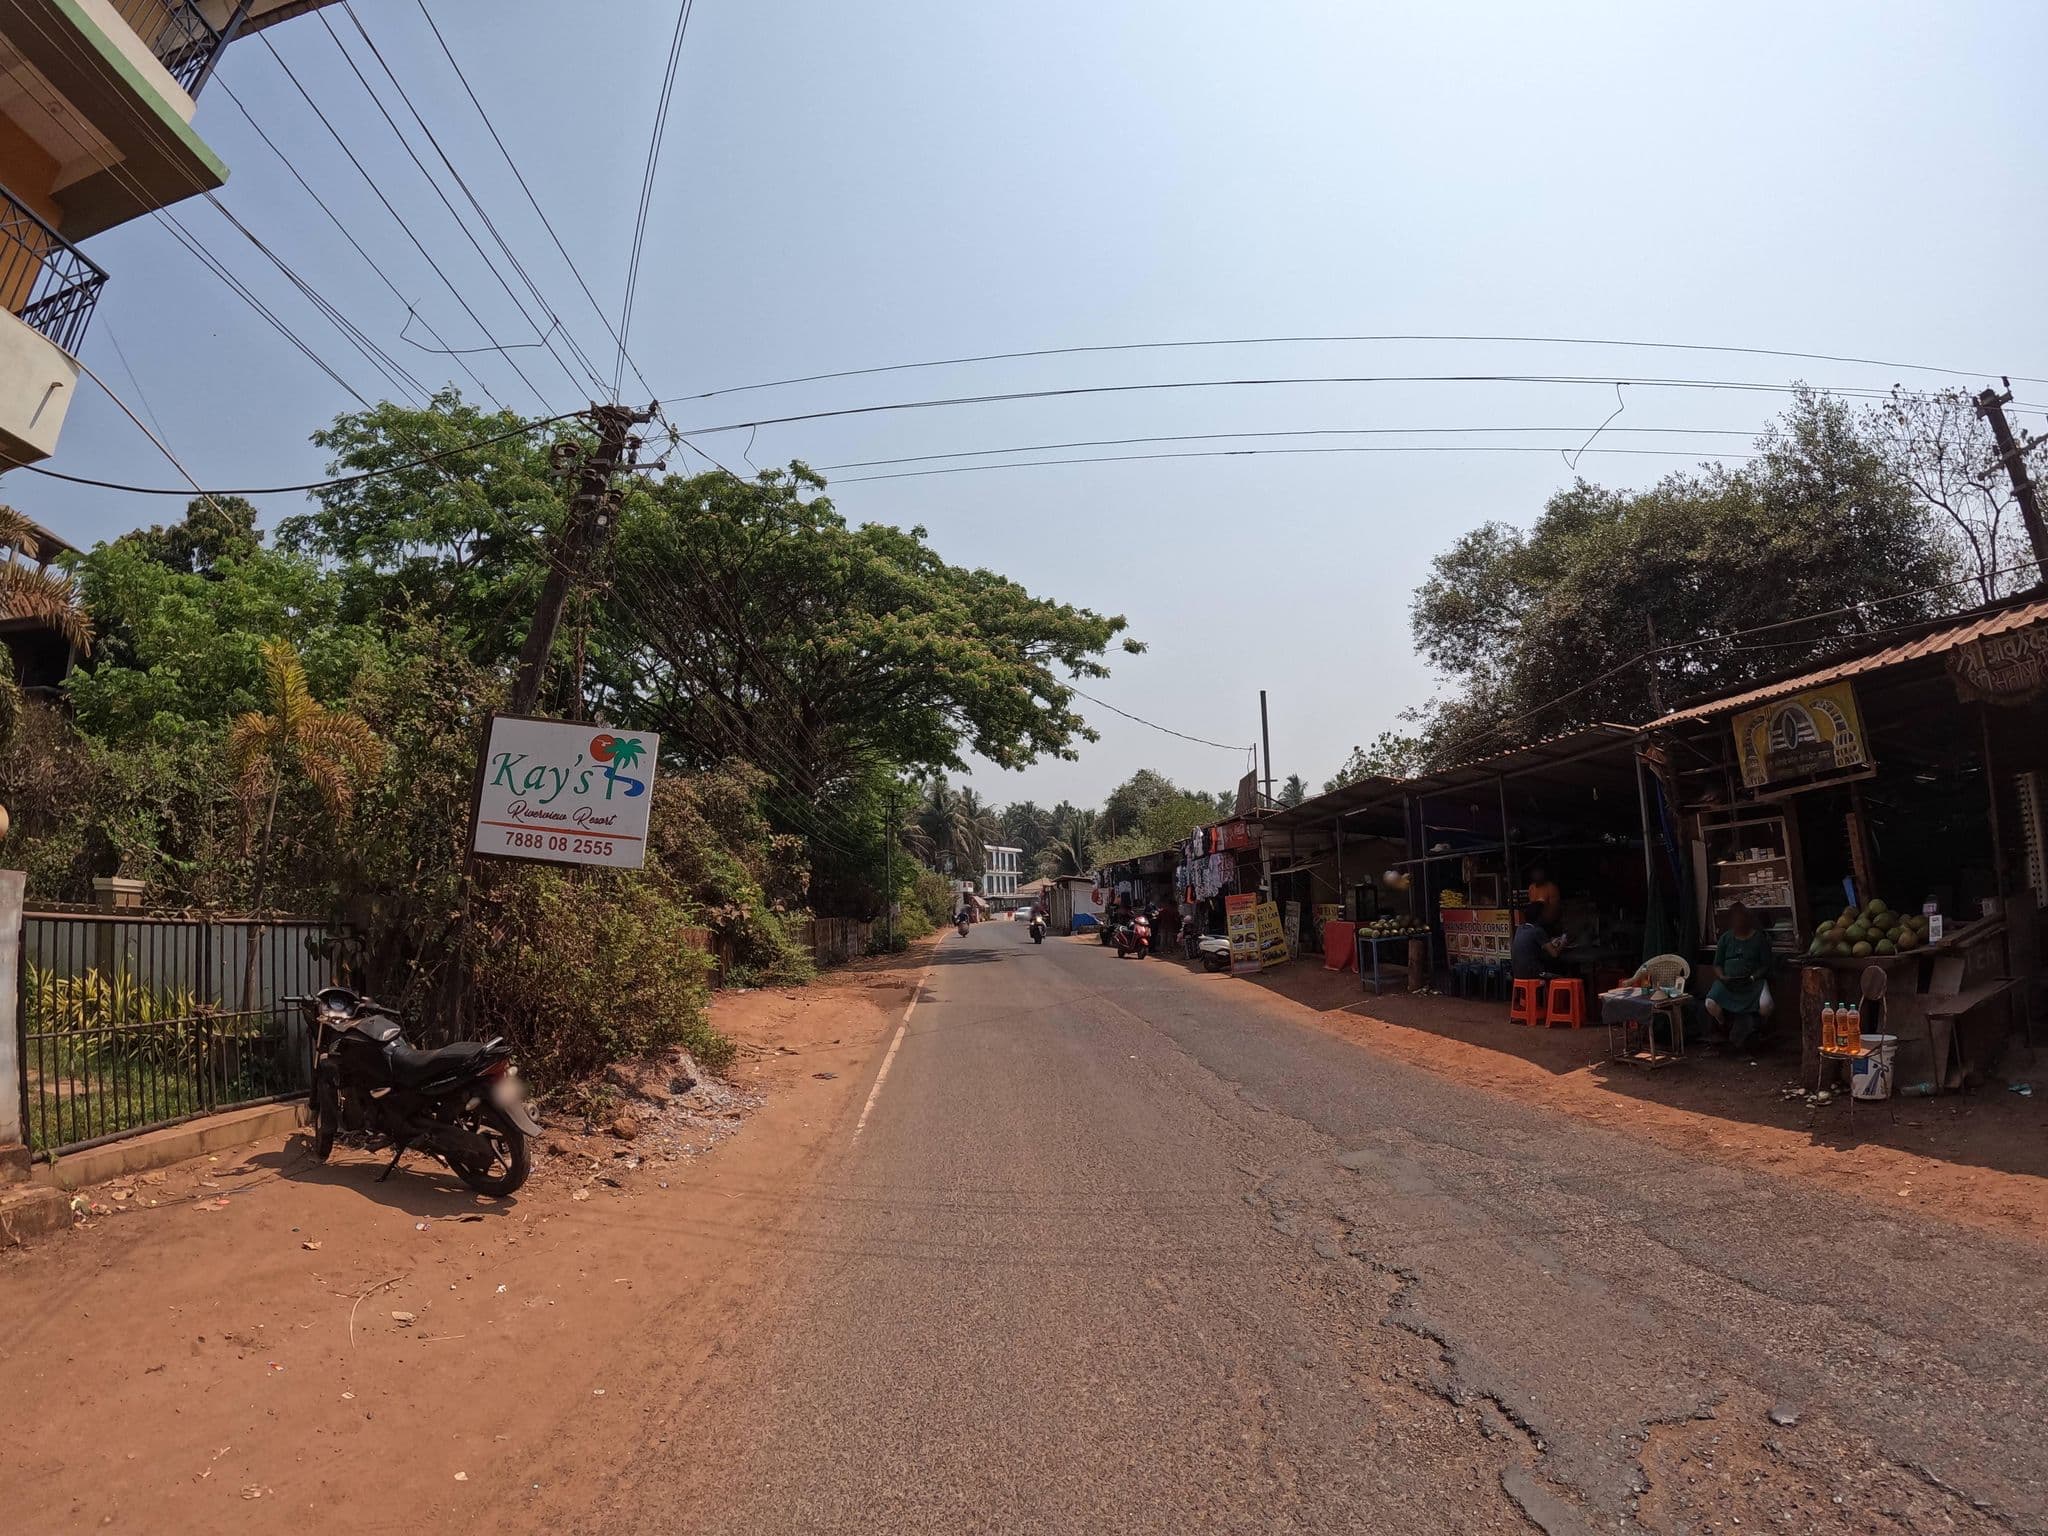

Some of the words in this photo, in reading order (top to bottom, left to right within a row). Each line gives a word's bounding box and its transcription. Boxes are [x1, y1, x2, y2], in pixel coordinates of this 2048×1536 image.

[490, 751, 594, 805] Kay's
[507, 799, 568, 824] Riverview
[573, 806, 618, 830] Resort
[505, 831, 544, 849] 7888
[548, 836, 568, 852] 08
[573, 839, 613, 856] 2555
[1464, 922, 1482, 932] FOOD
[1483, 923, 1510, 933] CORNER
